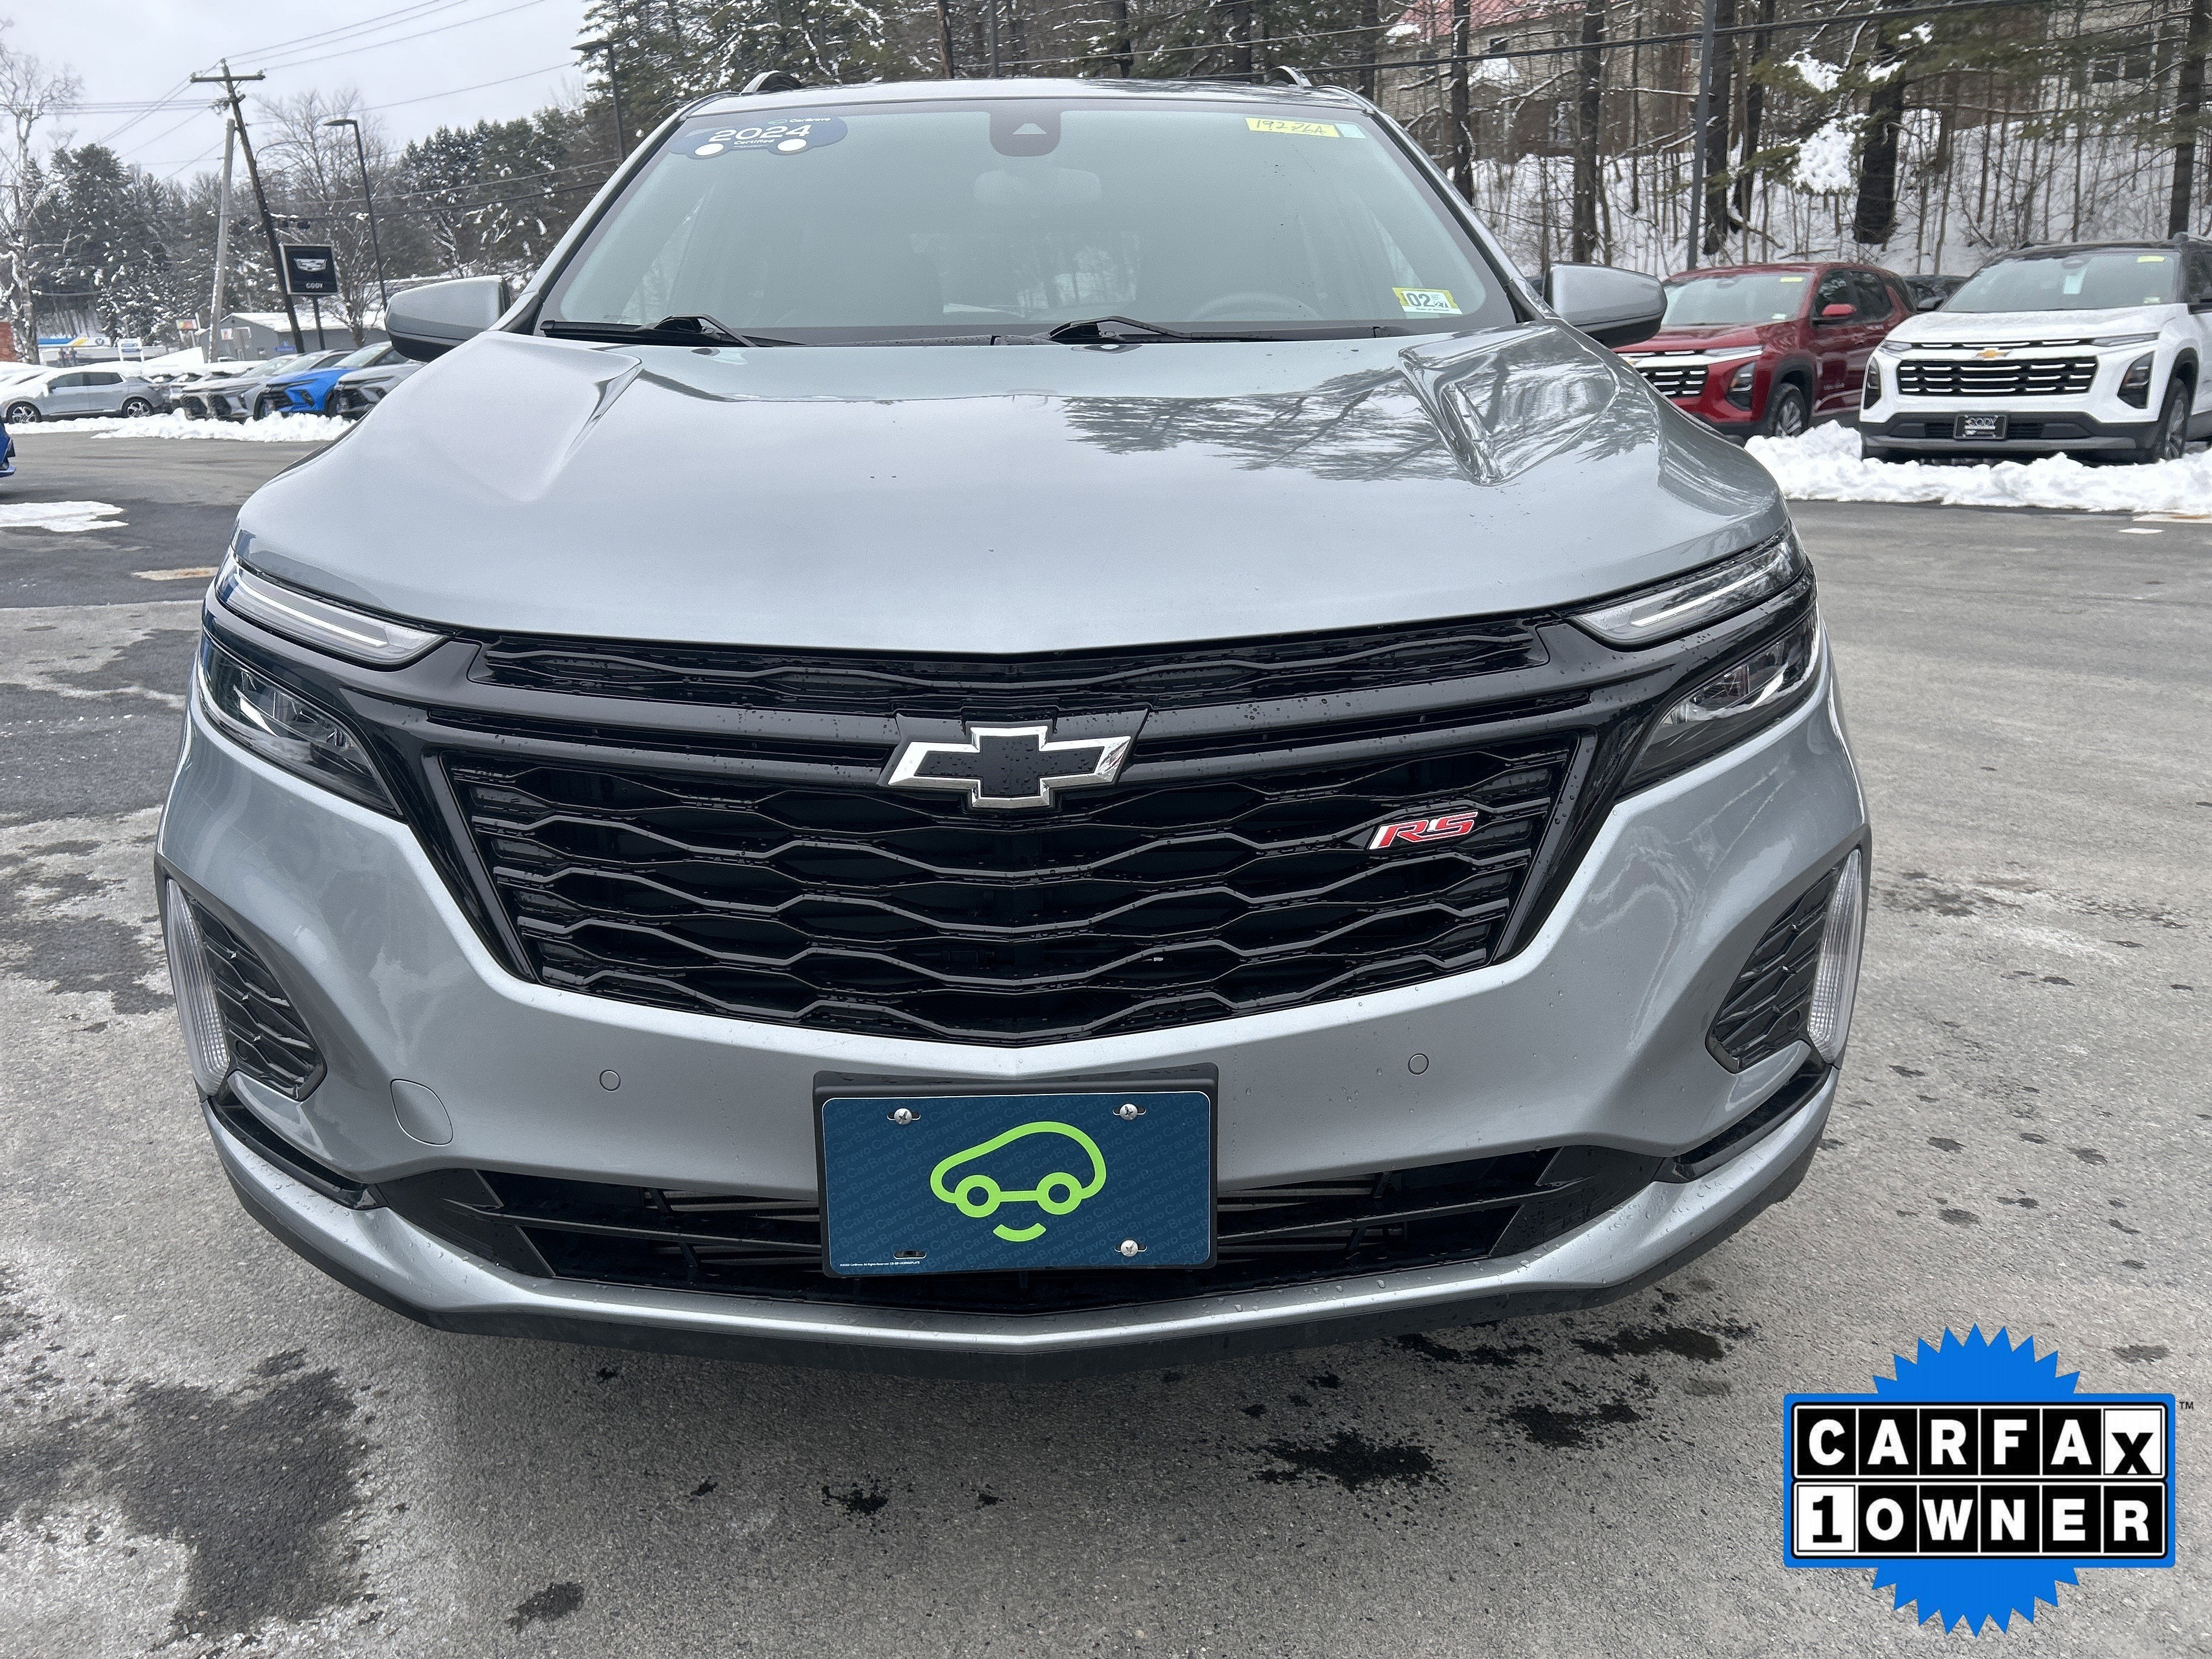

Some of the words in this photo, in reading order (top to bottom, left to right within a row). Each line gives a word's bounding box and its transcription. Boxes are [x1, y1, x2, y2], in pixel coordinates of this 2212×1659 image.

[708, 125, 812, 142] 2024
[1406, 293, 1435, 307] 02
[1369, 811, 1479, 850] RS
